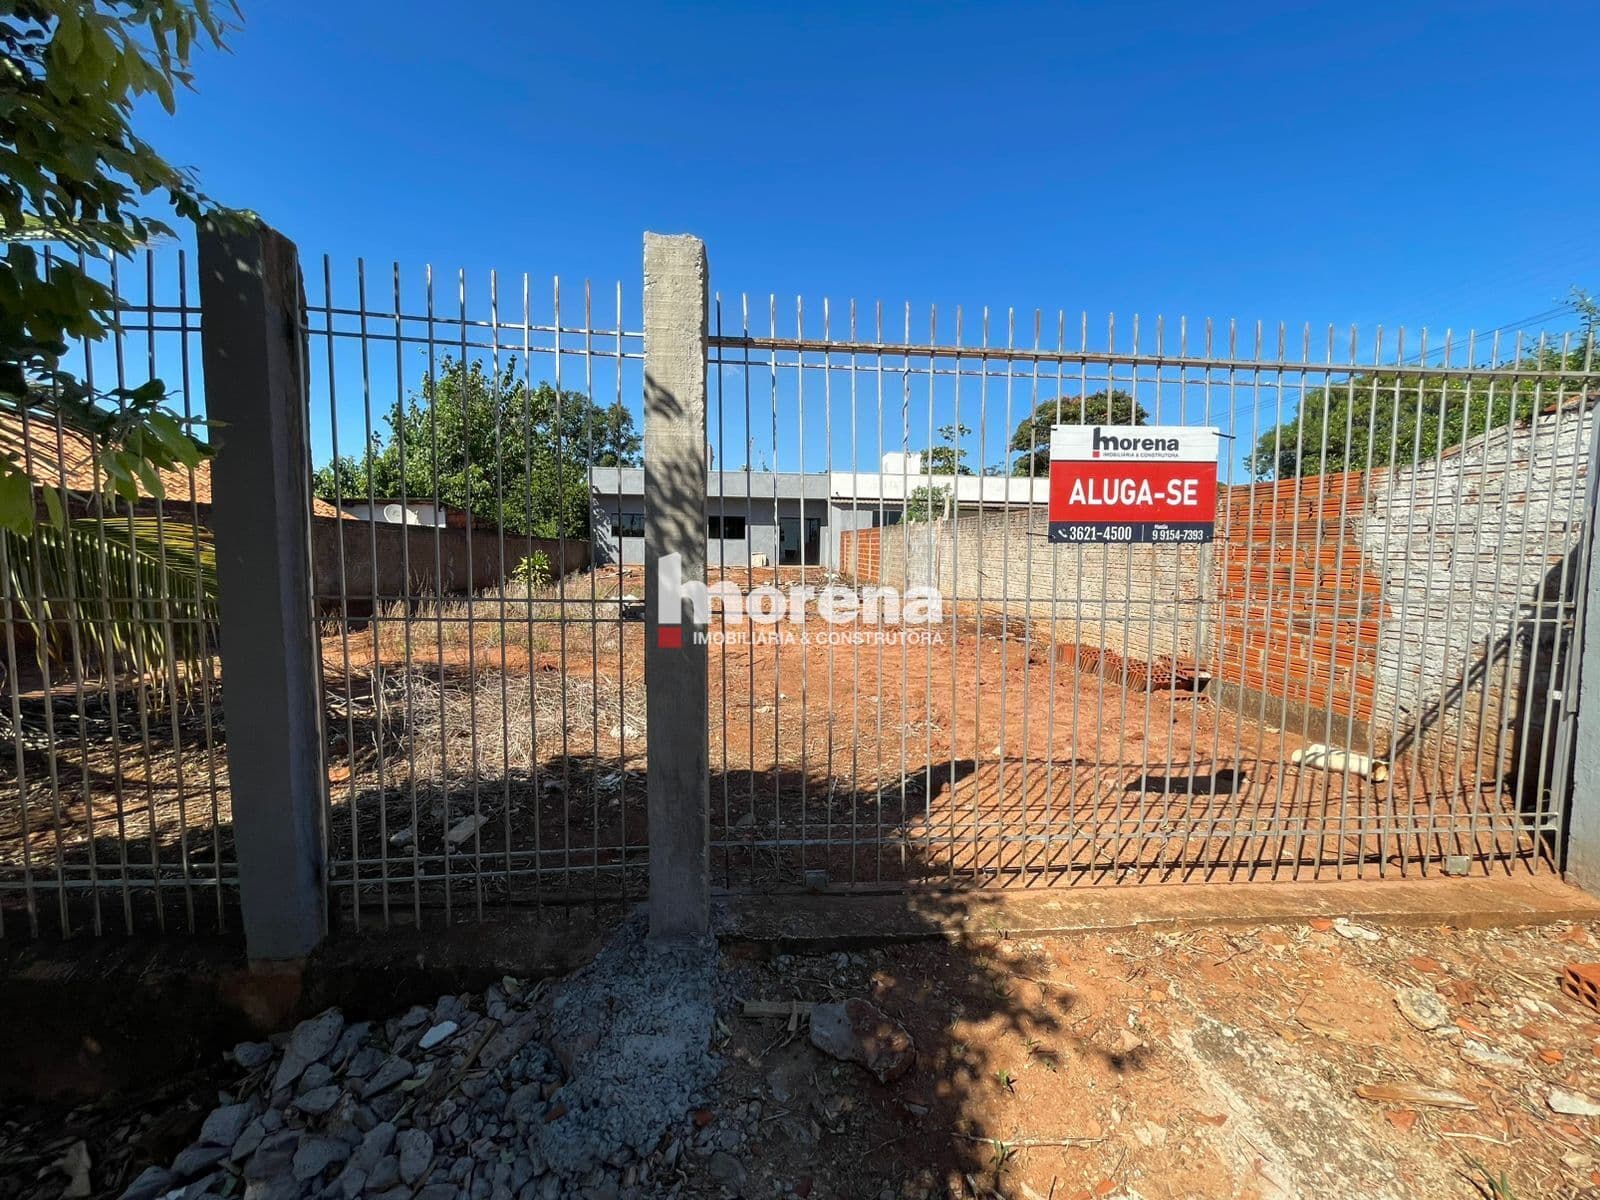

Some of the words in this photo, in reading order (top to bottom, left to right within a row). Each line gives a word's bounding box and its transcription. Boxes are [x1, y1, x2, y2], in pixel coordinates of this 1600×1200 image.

[1093, 427, 1180, 451] morena
[1069, 478, 1199, 506] ALUGA-SE
[1069, 525, 1132, 541] 3621-4500
[1152, 529, 1158, 541] 9
[1159, 529, 1204, 541] 9154-7393
